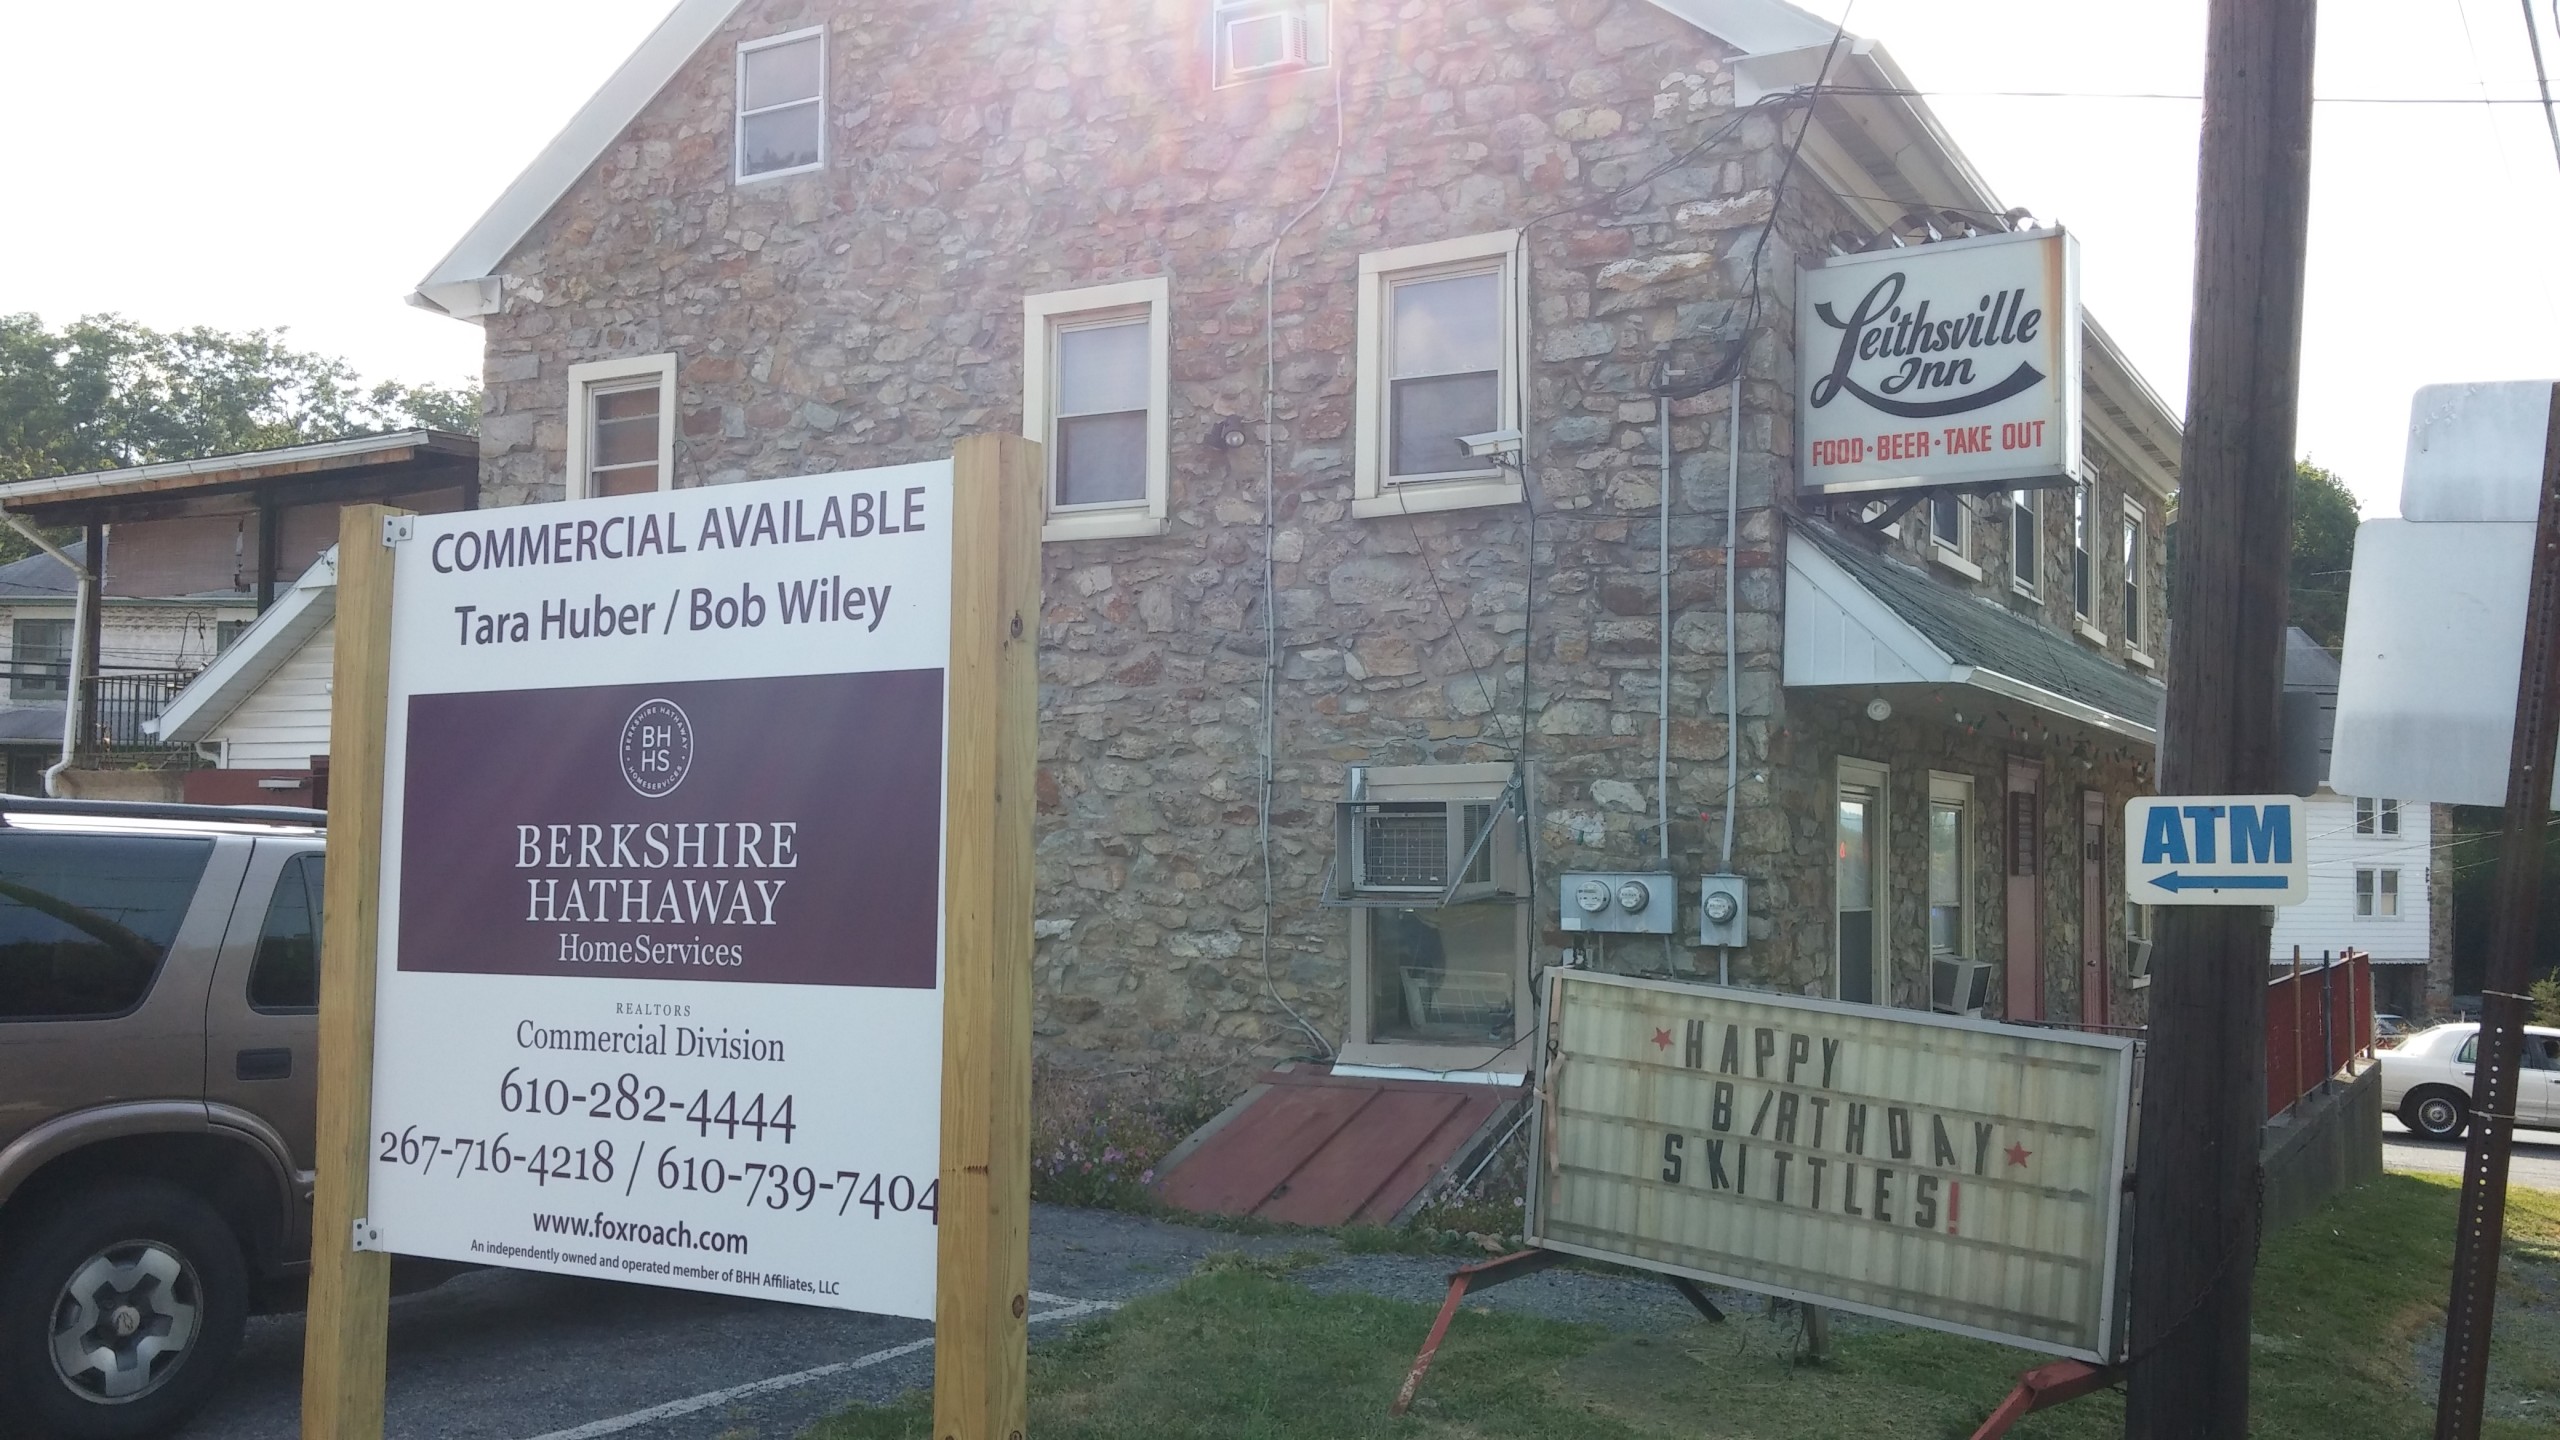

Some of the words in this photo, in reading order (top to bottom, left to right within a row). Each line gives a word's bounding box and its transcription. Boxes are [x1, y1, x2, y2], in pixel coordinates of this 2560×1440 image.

[1810, 271, 2042, 409] Leithsville
[1880, 357, 1976, 395] Inn
[1812, 437, 1864, 467] FOOD
[1876, 431, 1930, 462] BEER
[1943, 425, 1992, 456] TAKE
[2002, 420, 2046, 450] OUT
[431, 512, 687, 574] COMMERCIAL
[697, 486, 927, 553] AVAILABLE
[454, 604, 530, 647] Tara
[540, 593, 656, 642] Huber
[689, 582, 767, 632] Bob
[777, 575, 893, 633] Wiley
[625, 706, 657, 751] BERKSHIRE
[660, 706, 688, 750] HATHAWAY
[642, 725, 671, 748] BH
[628, 765, 683, 790] HOMESERVICES
[641, 749, 670, 772] HS
[515, 820, 799, 870] BERKSHIRE
[2141, 804, 2293, 865] ATM
[525, 878, 786, 927] HATHAWAY
[557, 932, 743, 967] HomeServices
[616, 1002, 691, 1017] REALTORS
[516, 1018, 667, 1056] Commercial
[675, 1025, 786, 1062] Division
[1684, 1019, 1840, 1090] HAPPY
[500, 1066, 797, 1145] 610-282-4444
[379, 1124, 614, 1187] 267-716-4218
[657, 1145, 940, 1226] 610-739-7404
[1662, 1132, 1960, 1236] SKITTLES!
[533, 1211, 748, 1255] www.foxroach.com
[470, 1239, 484, 1253] An
[486, 1240, 560, 1264] independently
[561, 1253, 597, 1266] owned
[599, 1255, 620, 1268] and
[621, 1259, 670, 1275] operated
[673, 1265, 719, 1280] member
[721, 1269, 734, 1283] of
[735, 1270, 760, 1285] BHH
[763, 1273, 816, 1294] Affiliates,
[818, 1280, 840, 1295] LLC
